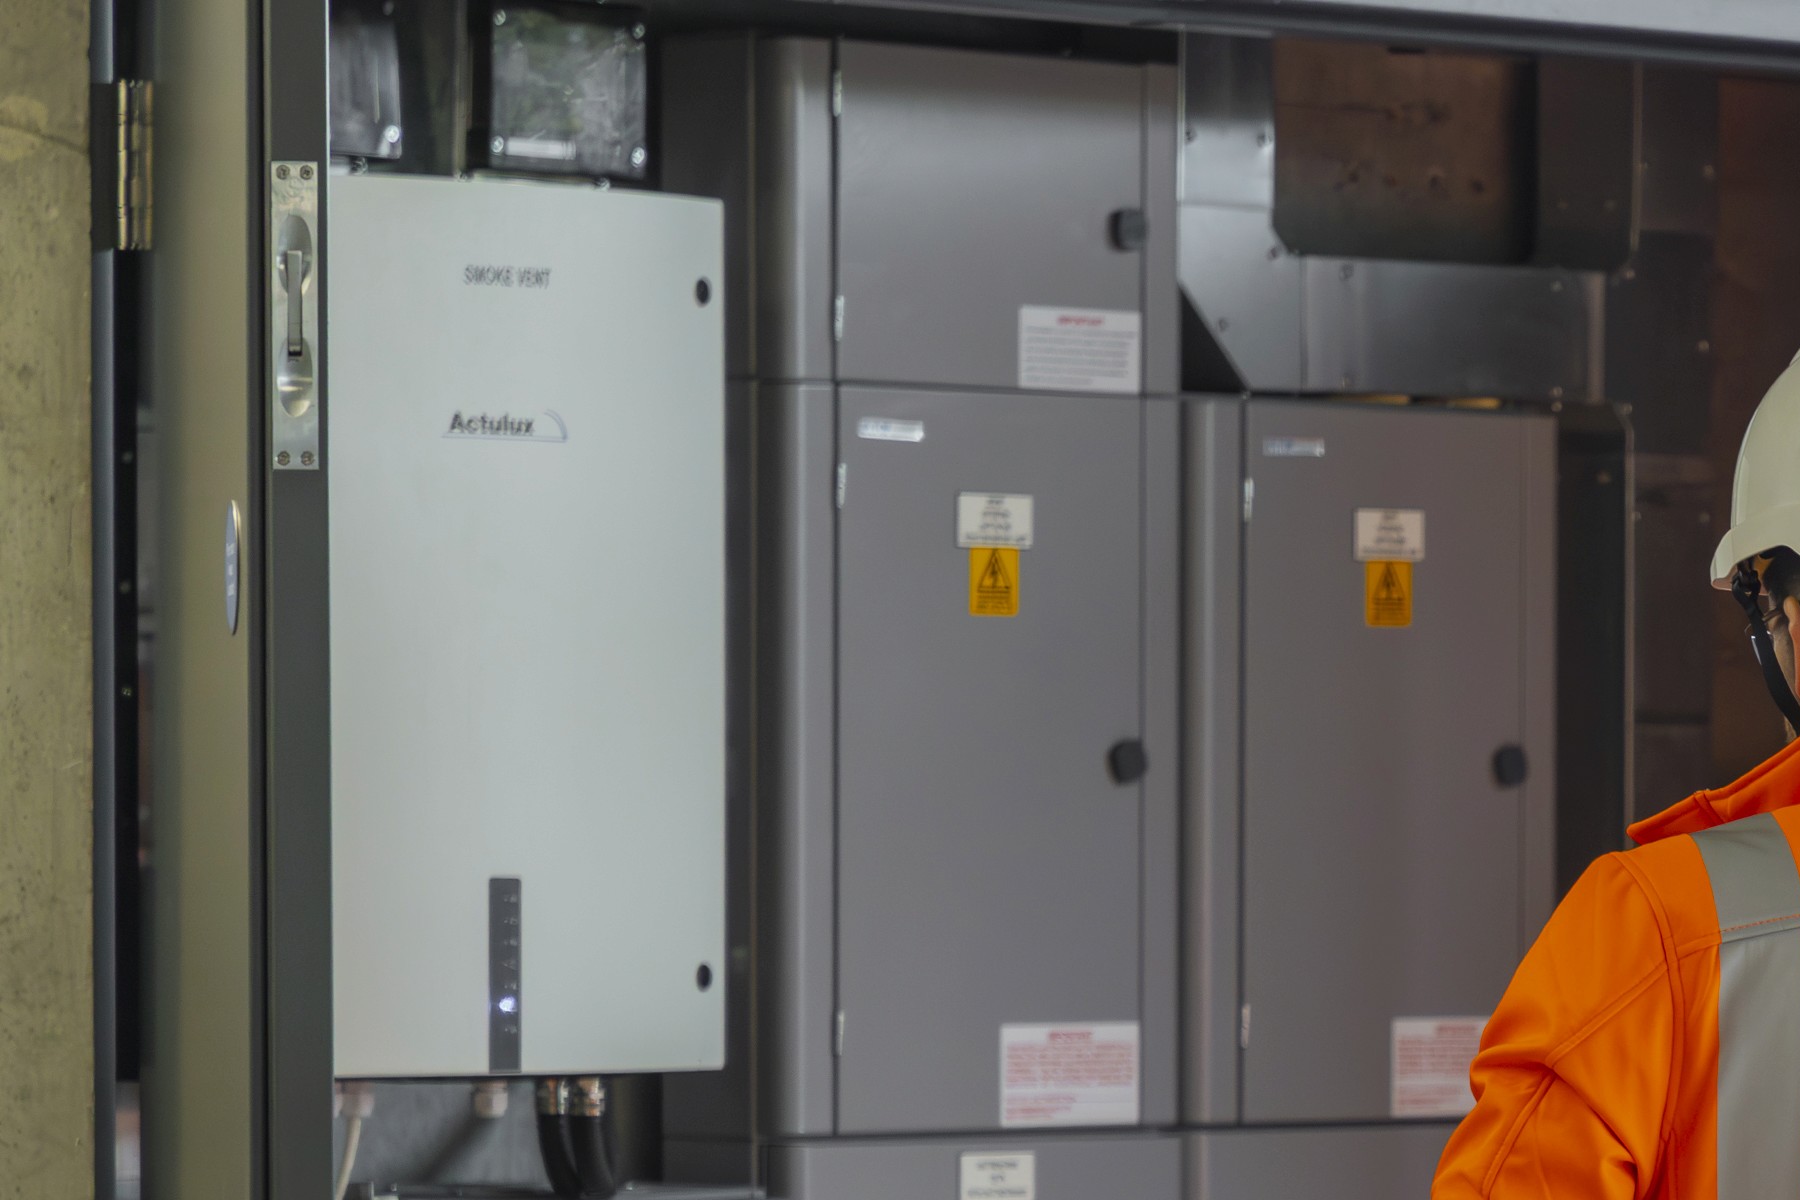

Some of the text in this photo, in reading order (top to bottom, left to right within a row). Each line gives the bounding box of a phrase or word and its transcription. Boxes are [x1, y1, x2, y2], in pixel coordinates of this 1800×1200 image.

[463, 264, 552, 289] SMOKE VENT
[449, 410, 535, 436] Actulux
